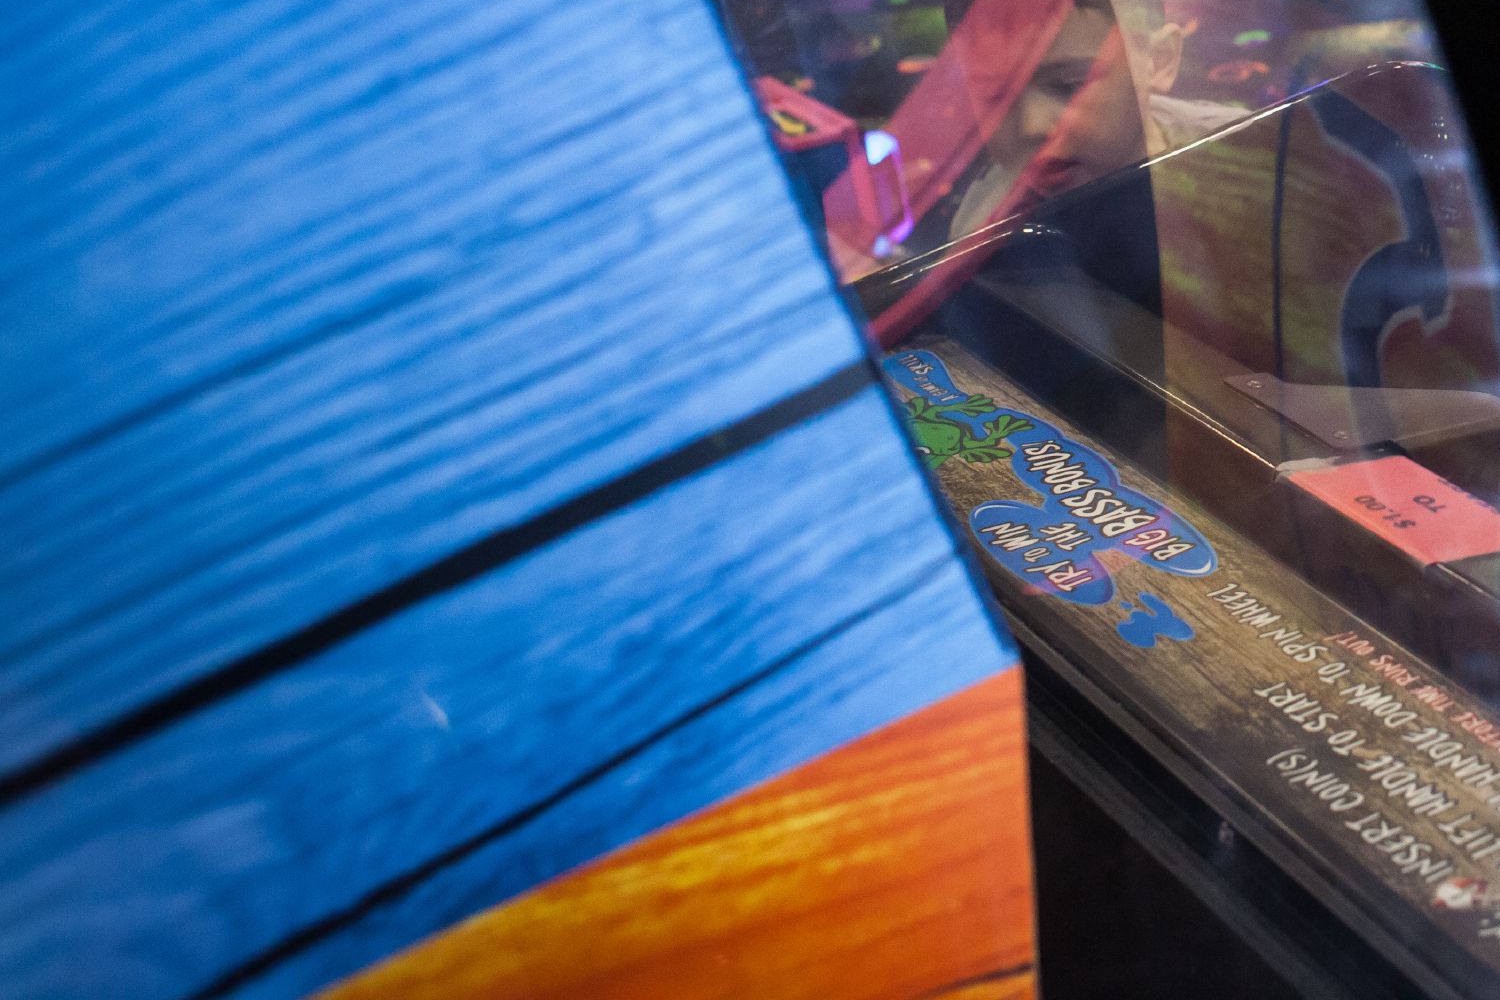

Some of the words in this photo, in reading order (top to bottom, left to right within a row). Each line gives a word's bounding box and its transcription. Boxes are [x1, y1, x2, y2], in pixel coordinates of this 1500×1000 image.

[1021, 440, 1097, 495] BONUS!
[1062, 489, 1156, 537] BASS
[1354, 495, 1416, 529] $1.00
[1412, 495, 1446, 513] TO
[979, 522, 1039, 551] WIN
[1040, 523, 1093, 551] THE
[1123, 529, 1195, 561] BIG
[1024, 547, 1049, 562] TO
[1025, 560, 1093, 592] TRY
[1206, 583, 1282, 628] WHEEL
[1258, 628, 1329, 663] SPIN
[1317, 662, 1350, 685] TO
[1369, 653, 1420, 686] RUNS
[1254, 682, 1340, 733] START
[1339, 683, 1419, 728] DOWN
[1409, 684, 1455, 712] TIME
[1327, 729, 1367, 757] TO
[1266, 748, 1366, 812] COIN(S)
[1356, 754, 1456, 817] HANDLE
[1345, 811, 1454, 885] INSERT
